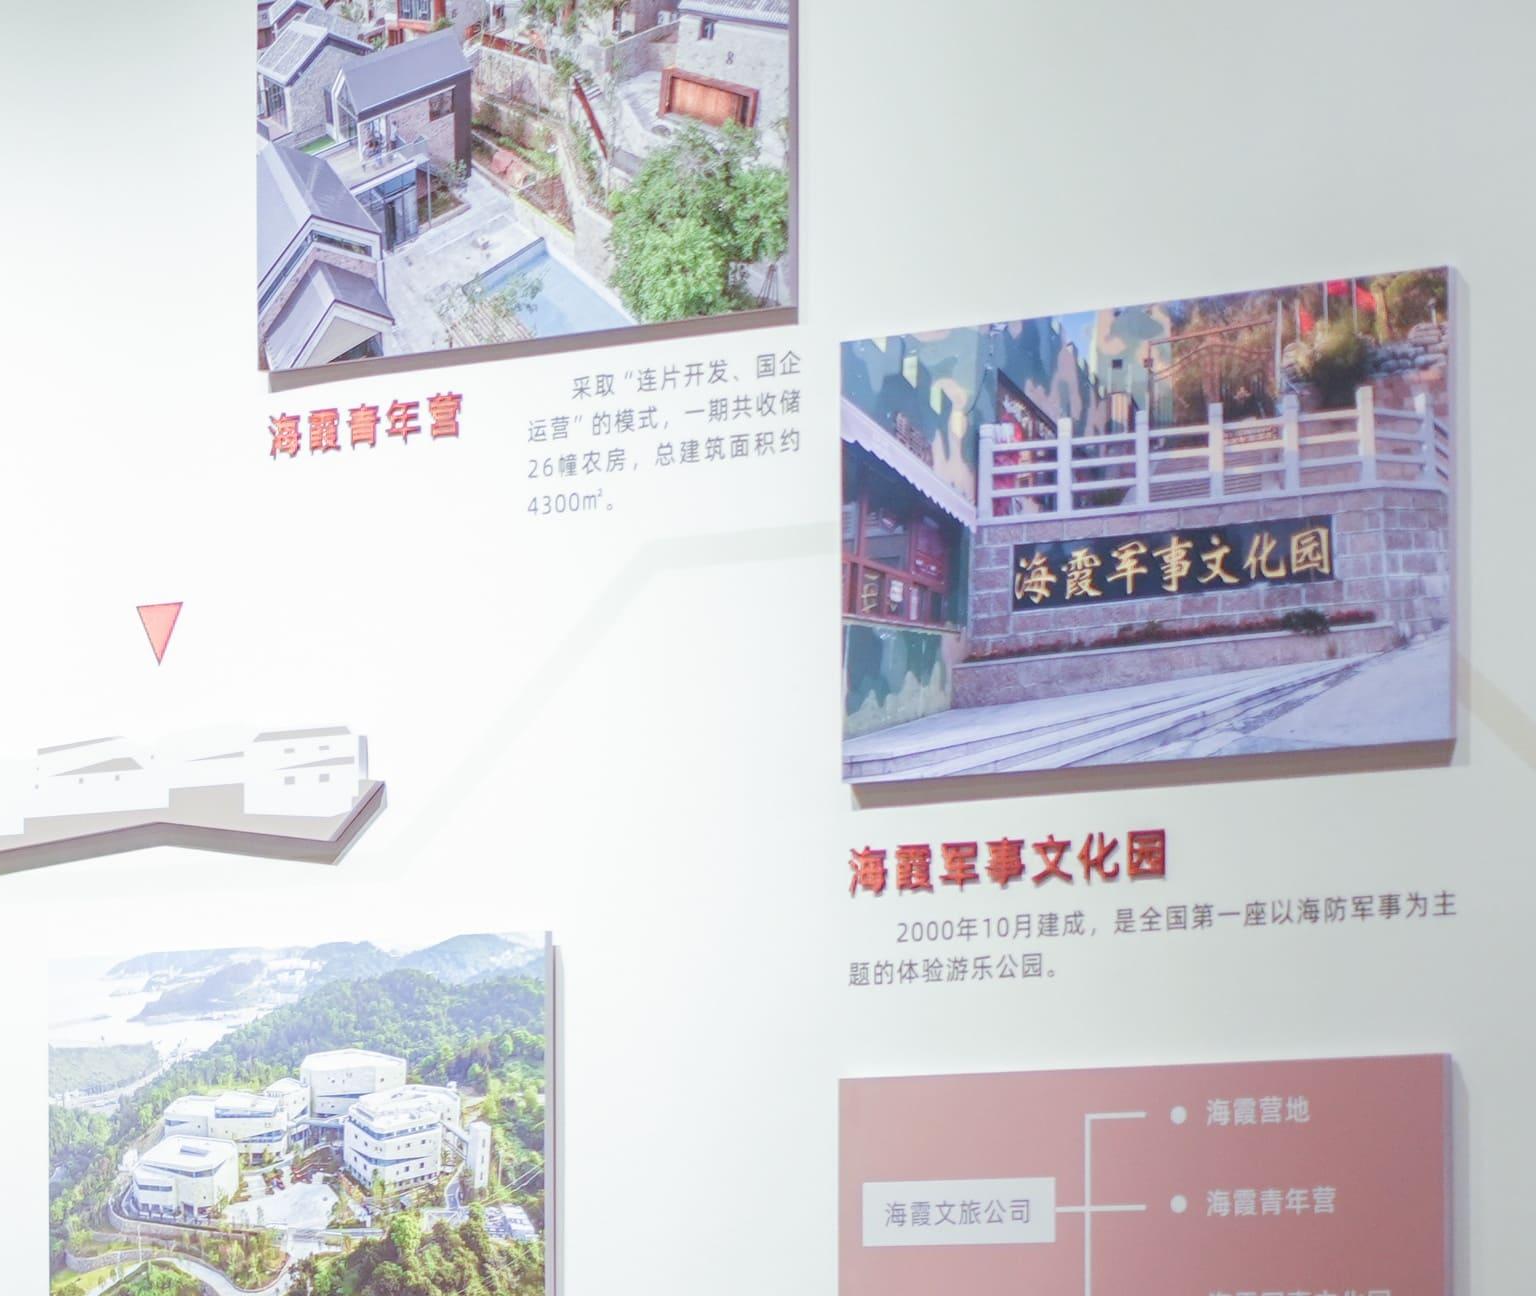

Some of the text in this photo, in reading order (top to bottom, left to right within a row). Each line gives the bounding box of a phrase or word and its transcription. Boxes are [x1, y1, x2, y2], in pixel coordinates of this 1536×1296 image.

[268, 392, 463, 460] 海霞青年营
[1014, 527, 1332, 605] 海霞军事文化园
[848, 829, 1167, 898] 海霞军事文化园
[848, 952, 1059, 987] 题的体验游乐公园。
[1206, 1096, 1311, 1127] 海霞营地
[884, 1199, 1032, 1228] 海霞文旅公司
[1206, 1186, 1337, 1218] 海霞青年营
